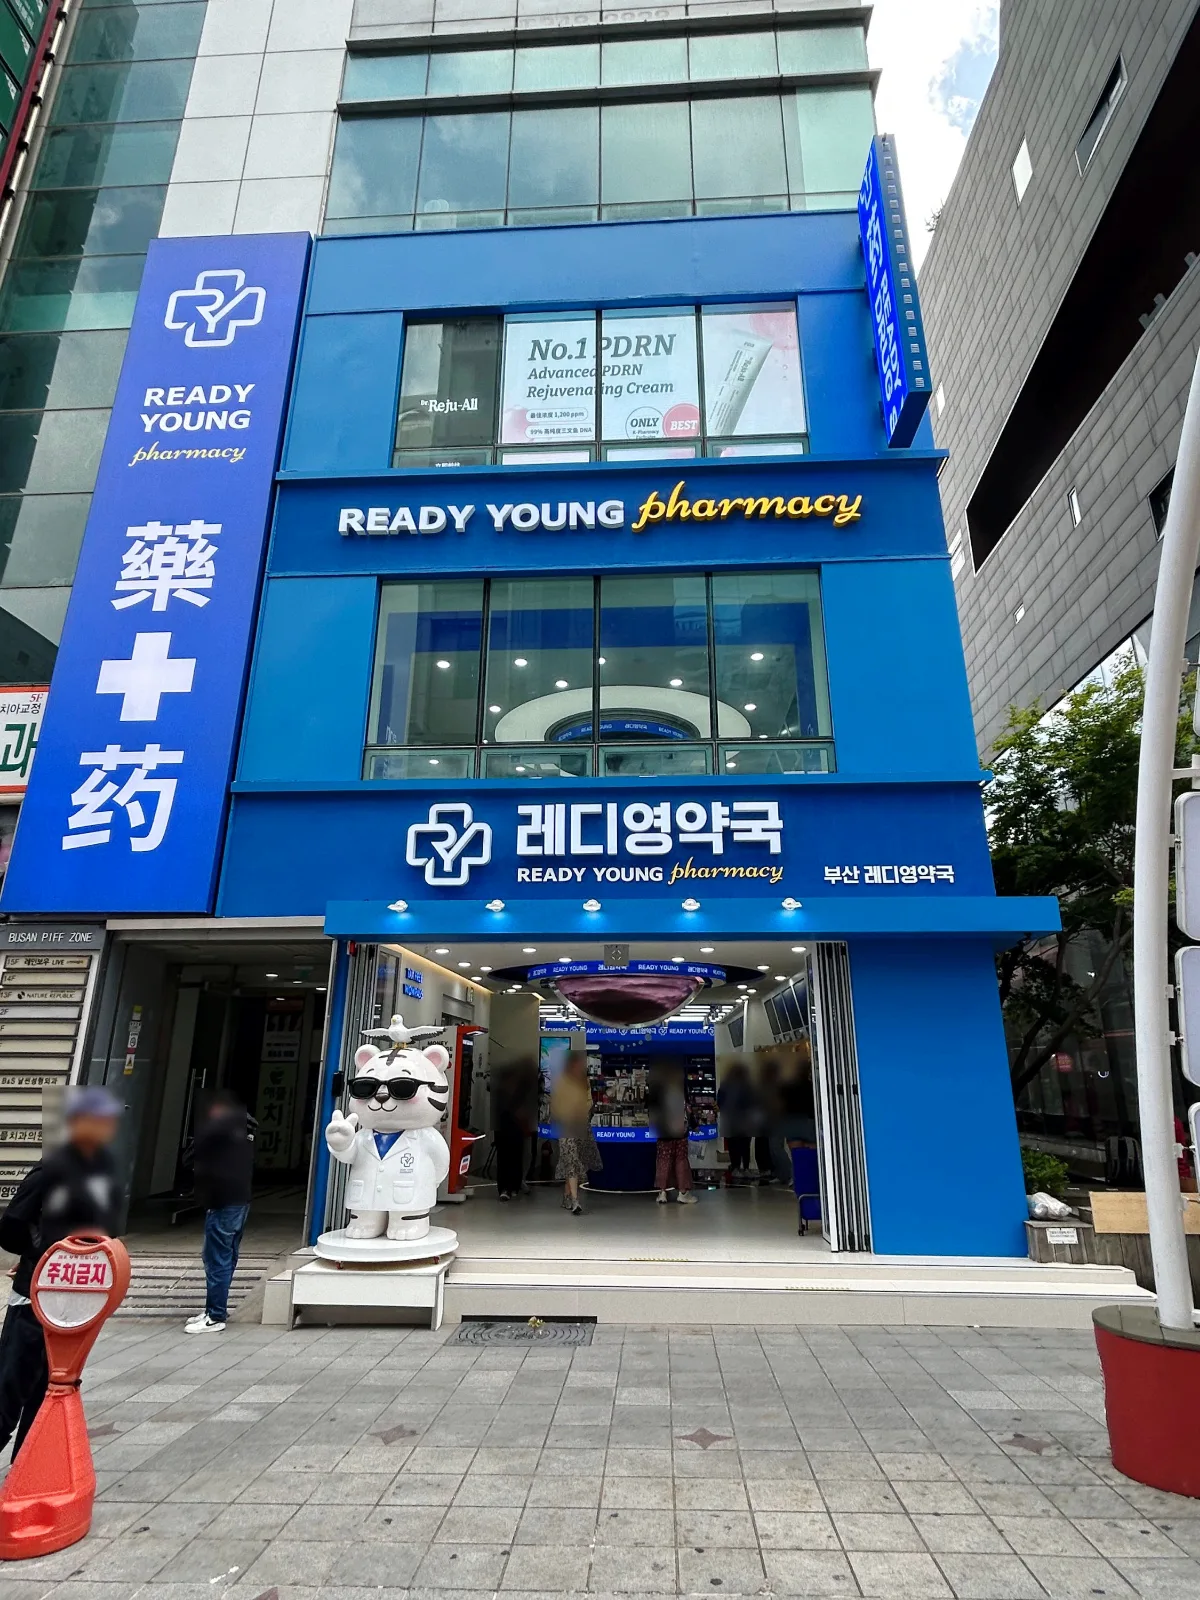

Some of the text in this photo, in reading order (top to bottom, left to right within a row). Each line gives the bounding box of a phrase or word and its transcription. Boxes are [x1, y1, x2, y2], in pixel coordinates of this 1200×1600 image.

[527, 337, 587, 362] No.1
[602, 363, 643, 377] PDRN
[143, 383, 256, 407] READY
[527, 382, 674, 402] Rejuvenaing Cream
[140, 410, 251, 433] YOUNG
[579, 426, 592, 434] DNA
[630, 417, 660, 428] ONLY
[670, 419, 698, 431] BEST
[128, 441, 246, 467] pharmacy
[338, 480, 864, 537] READY YOUNG pharmacy
[110, 519, 223, 612] 藥
[62, 743, 185, 853] 药
[515, 800, 784, 858] 레디영약국
[517, 856, 784, 886] READY YOUNG pharmacy
[823, 864, 955, 885] 부산 레디영약국
[8, 932, 93, 943] BUSAN PIFF ZONE
[638, 963, 658, 971] READY
[659, 963, 680, 972] YOUNG
[596, 1131, 615, 1139] READY
[615, 1131, 636, 1139] YOUNG
[47, 1262, 107, 1285] 주차금지
